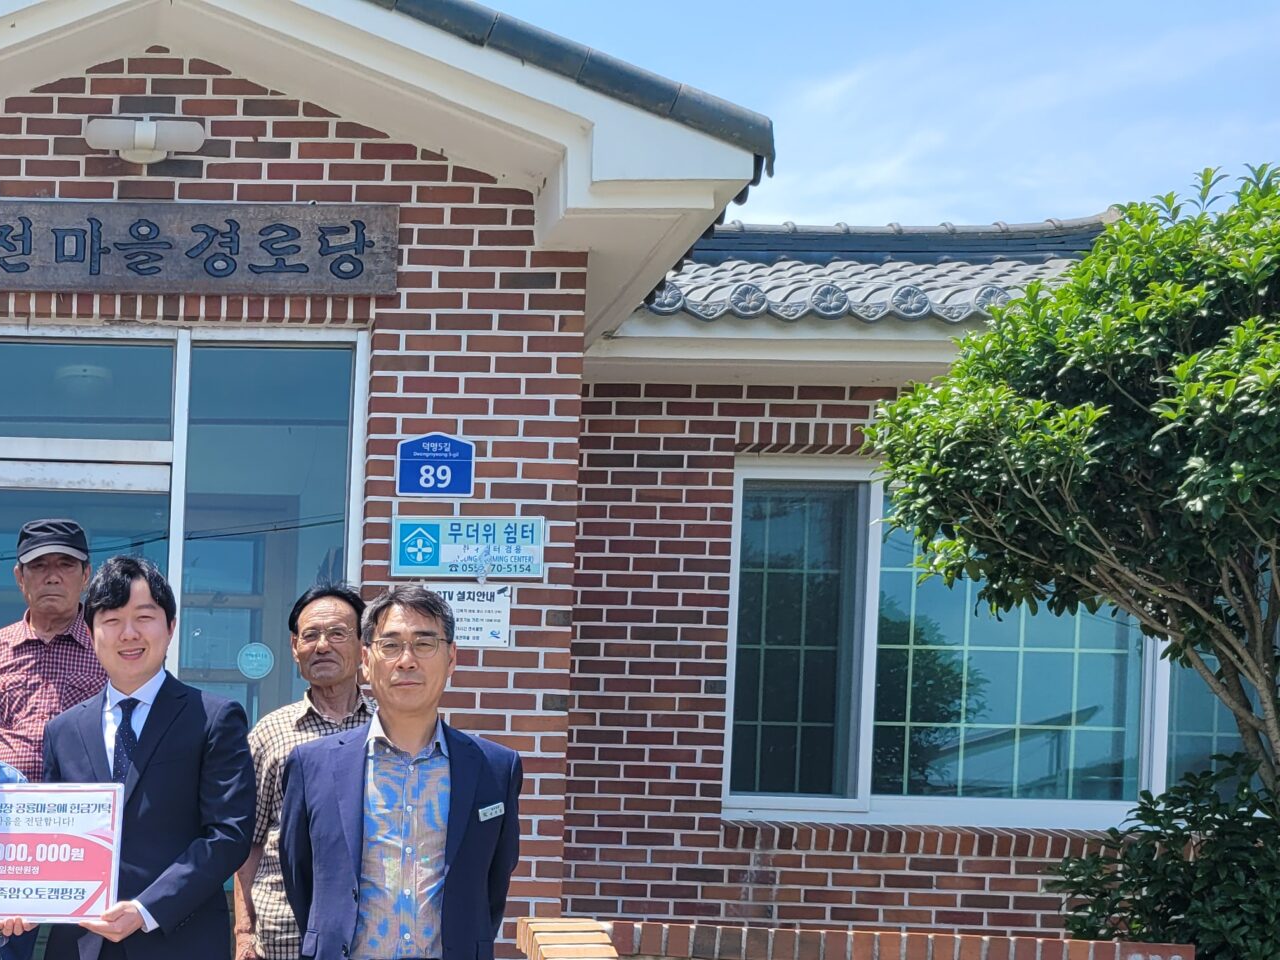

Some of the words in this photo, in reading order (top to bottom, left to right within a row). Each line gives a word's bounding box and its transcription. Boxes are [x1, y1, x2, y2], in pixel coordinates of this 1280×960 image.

[422, 442, 451, 451] 덕명5길
[419, 464, 452, 488] 89
[448, 523, 496, 544] 무더위
[503, 523, 535, 544] 쉼터
[456, 591, 495, 602] 설치안내
[15, 802, 68, 814] 공룡마을에
[25, 816, 75, 827] 전달합니다!
